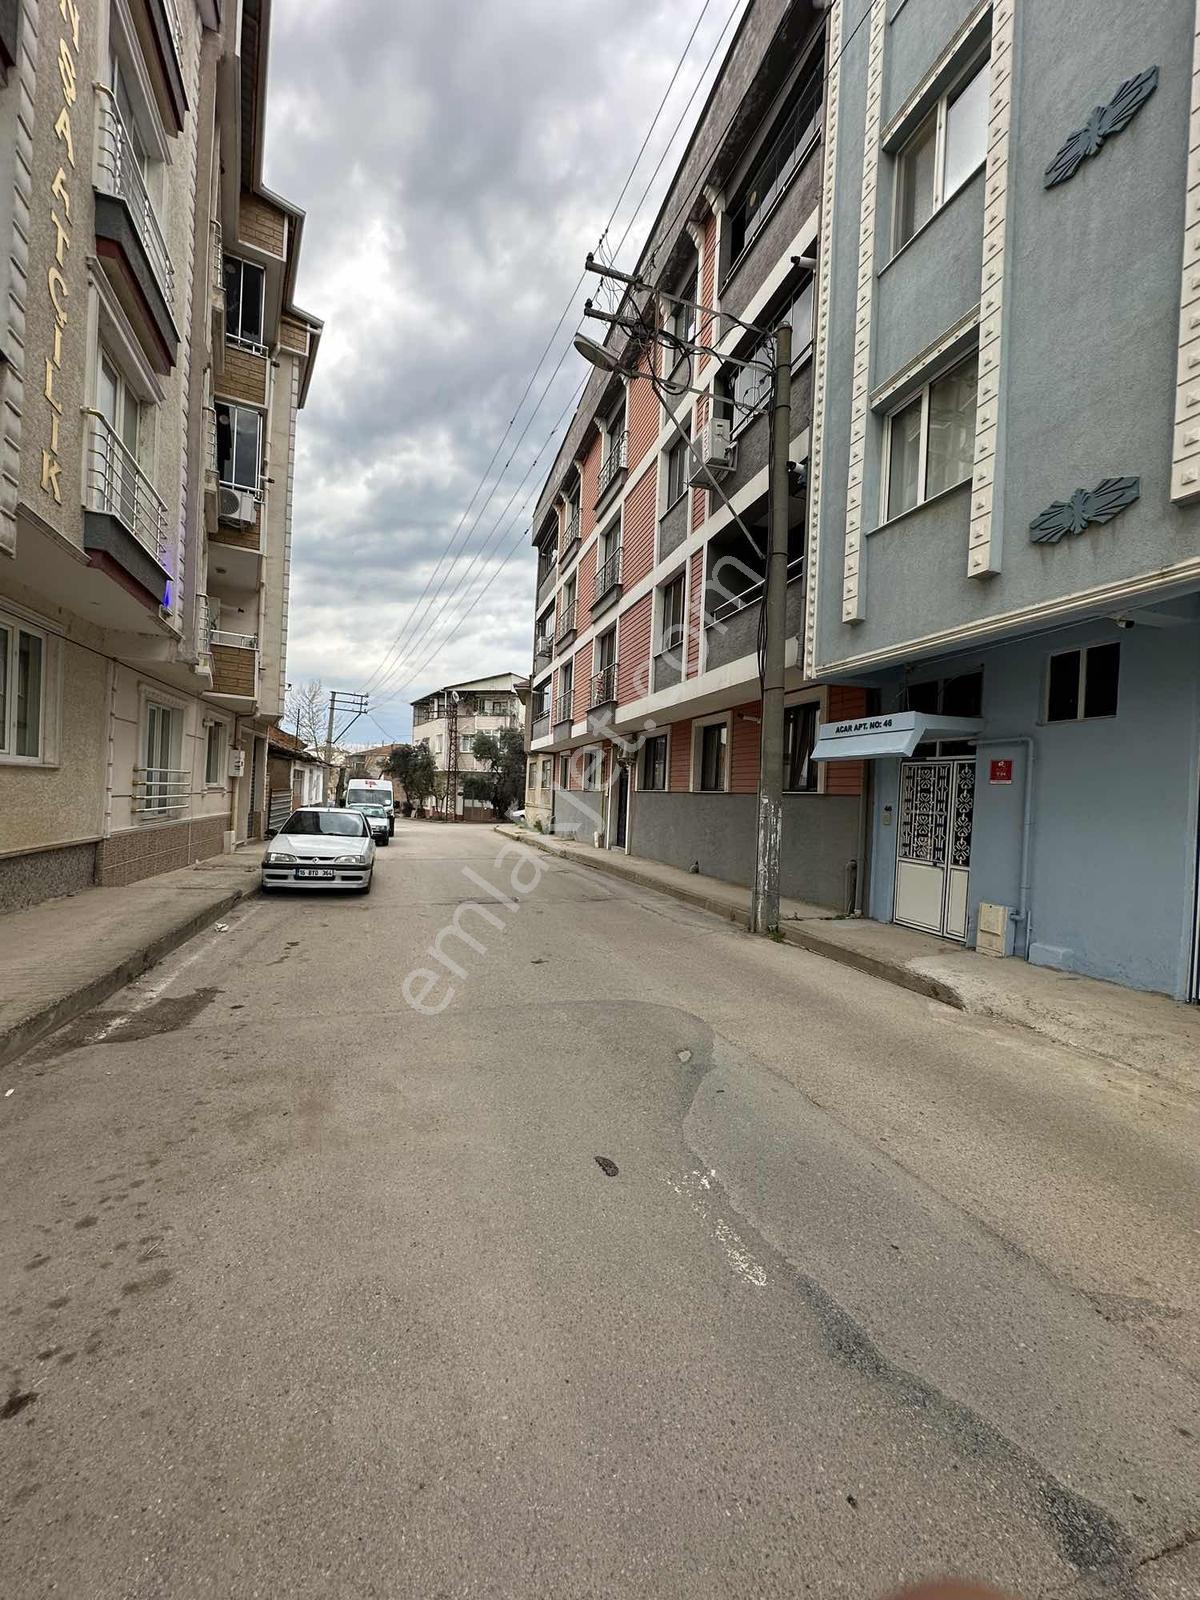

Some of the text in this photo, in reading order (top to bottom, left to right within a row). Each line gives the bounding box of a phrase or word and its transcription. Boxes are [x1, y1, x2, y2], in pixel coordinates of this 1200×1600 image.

[835, 724, 853, 734] ACAR
[853, 722, 868, 732] APT.
[869, 721, 882, 730] NO:
